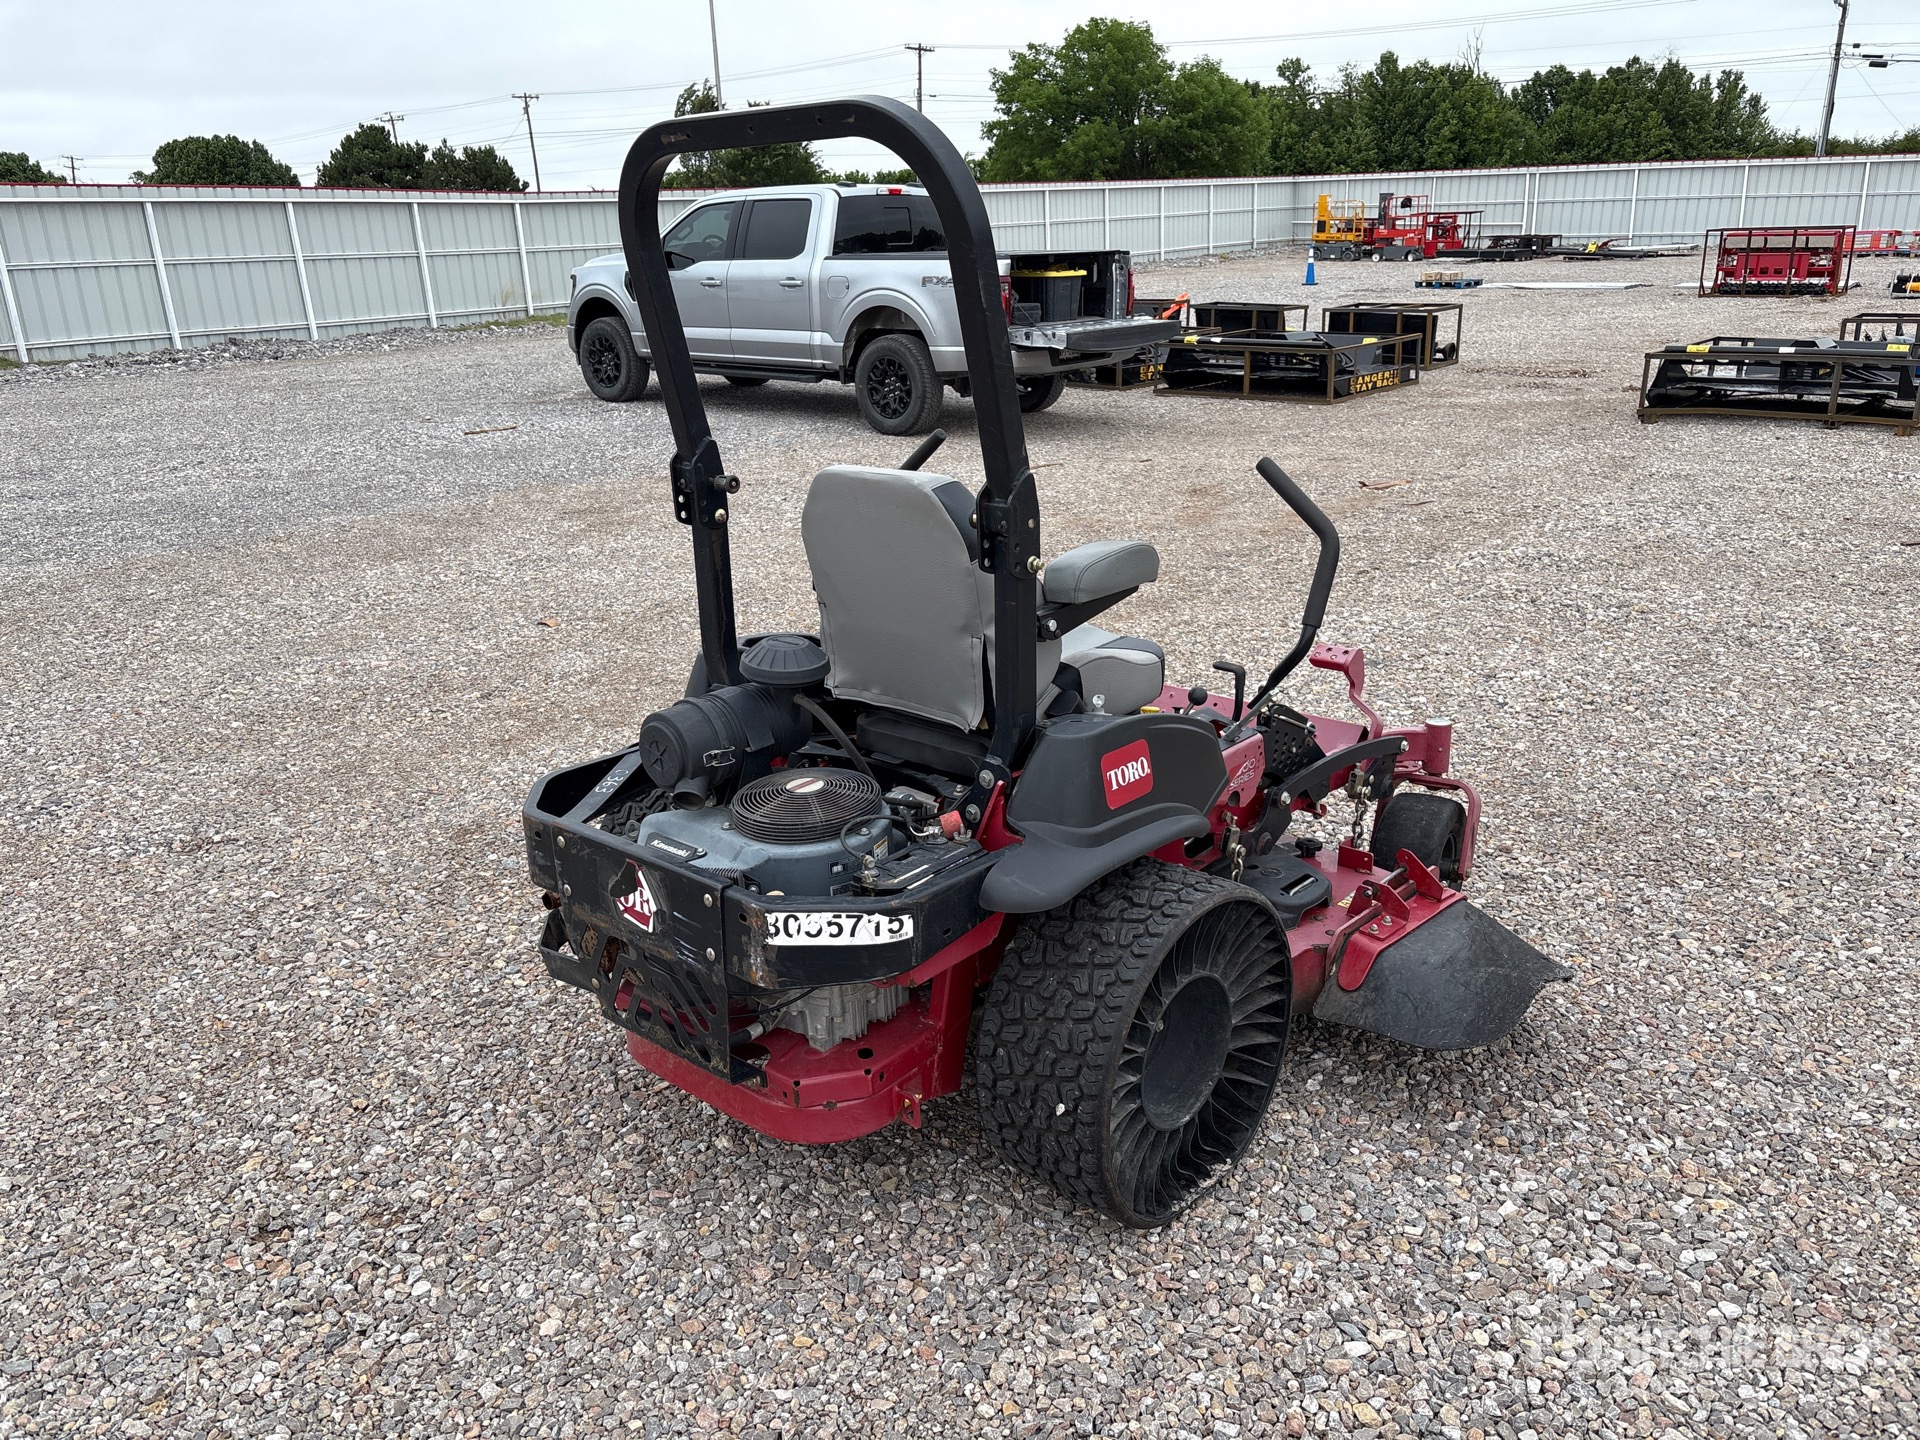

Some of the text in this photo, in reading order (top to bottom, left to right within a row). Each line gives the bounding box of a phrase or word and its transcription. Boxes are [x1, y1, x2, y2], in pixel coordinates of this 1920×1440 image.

[1349, 377, 1399, 393] STAY BACK
[595, 769, 629, 793] 0363
[650, 839, 691, 858] Kawasaki
